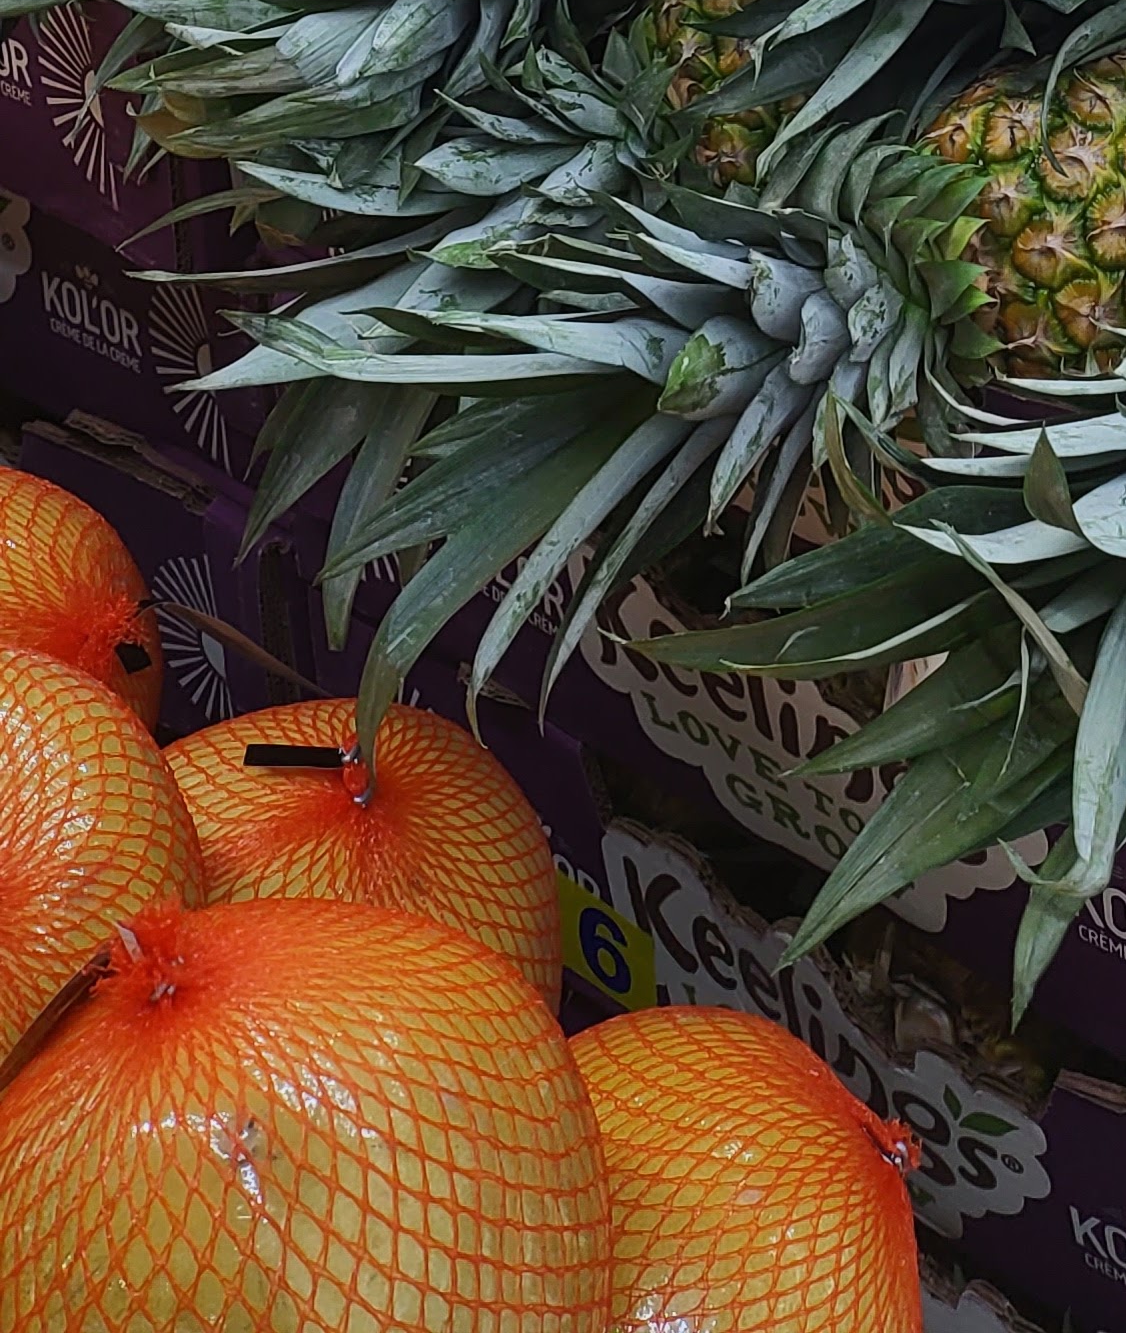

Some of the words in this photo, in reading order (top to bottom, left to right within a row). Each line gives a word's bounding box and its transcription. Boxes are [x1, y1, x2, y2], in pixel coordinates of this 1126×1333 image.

[41, 271, 143, 358] KOL'OR
[725, 773, 847, 860] GRO
[578, 907, 631, 994] 6
